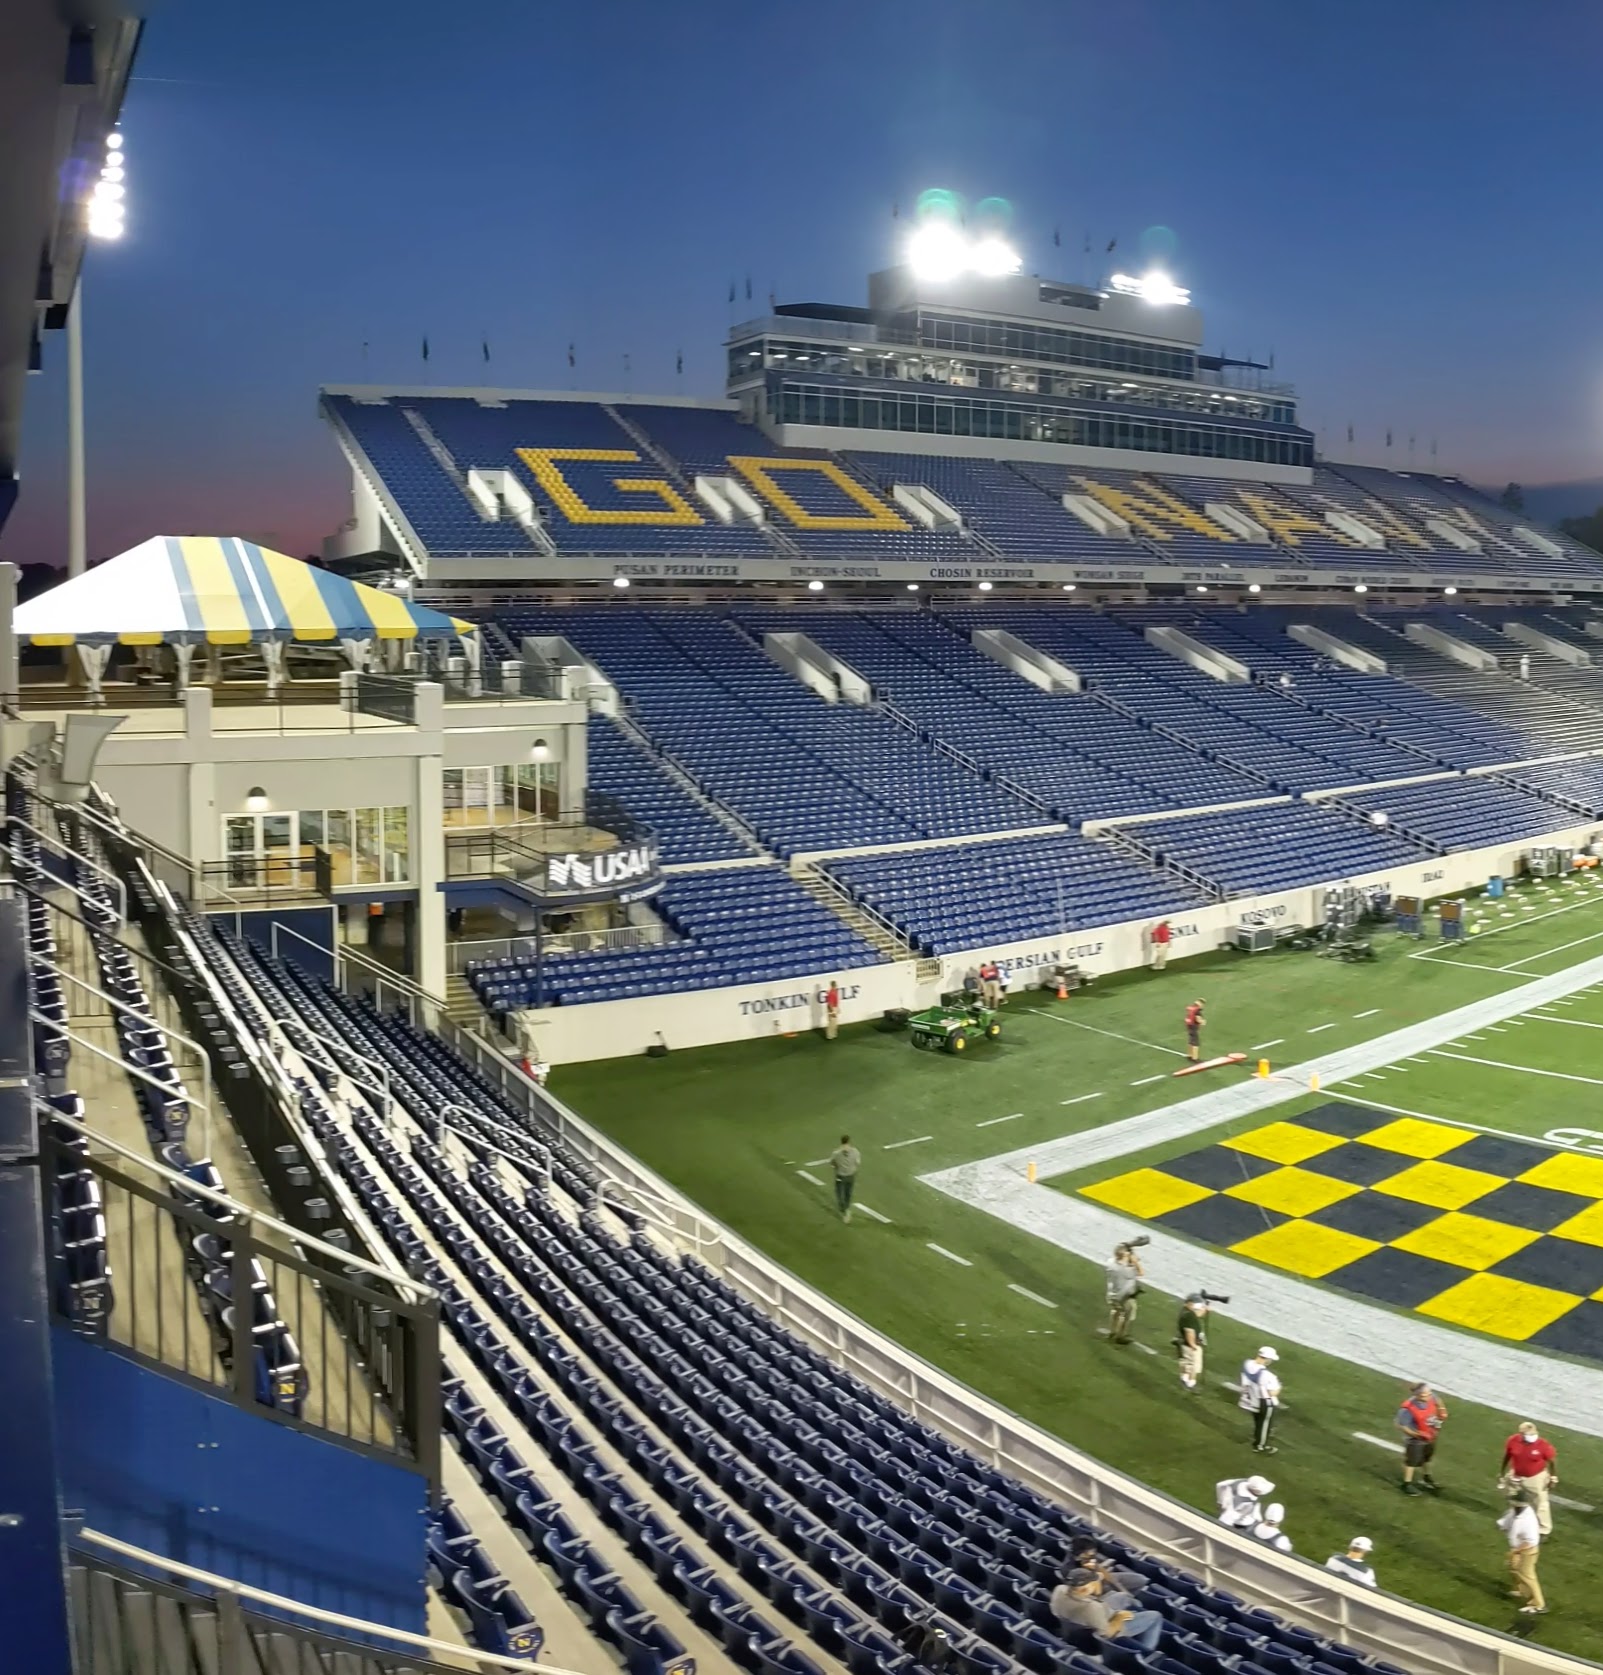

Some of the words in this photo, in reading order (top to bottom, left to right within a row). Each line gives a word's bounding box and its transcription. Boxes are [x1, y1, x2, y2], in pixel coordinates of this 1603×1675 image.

[514, 447, 914, 532] GO
[663, 565, 741, 577] PERIMETER
[929, 567, 972, 579] CHOSIN
[976, 568, 1035, 579] RESERVOIR
[1240, 904, 1287, 923] KOSOVO
[1066, 942, 1105, 960] GULF
[738, 992, 809, 1016] TONKIN
[816, 984, 861, 1004] GLF
